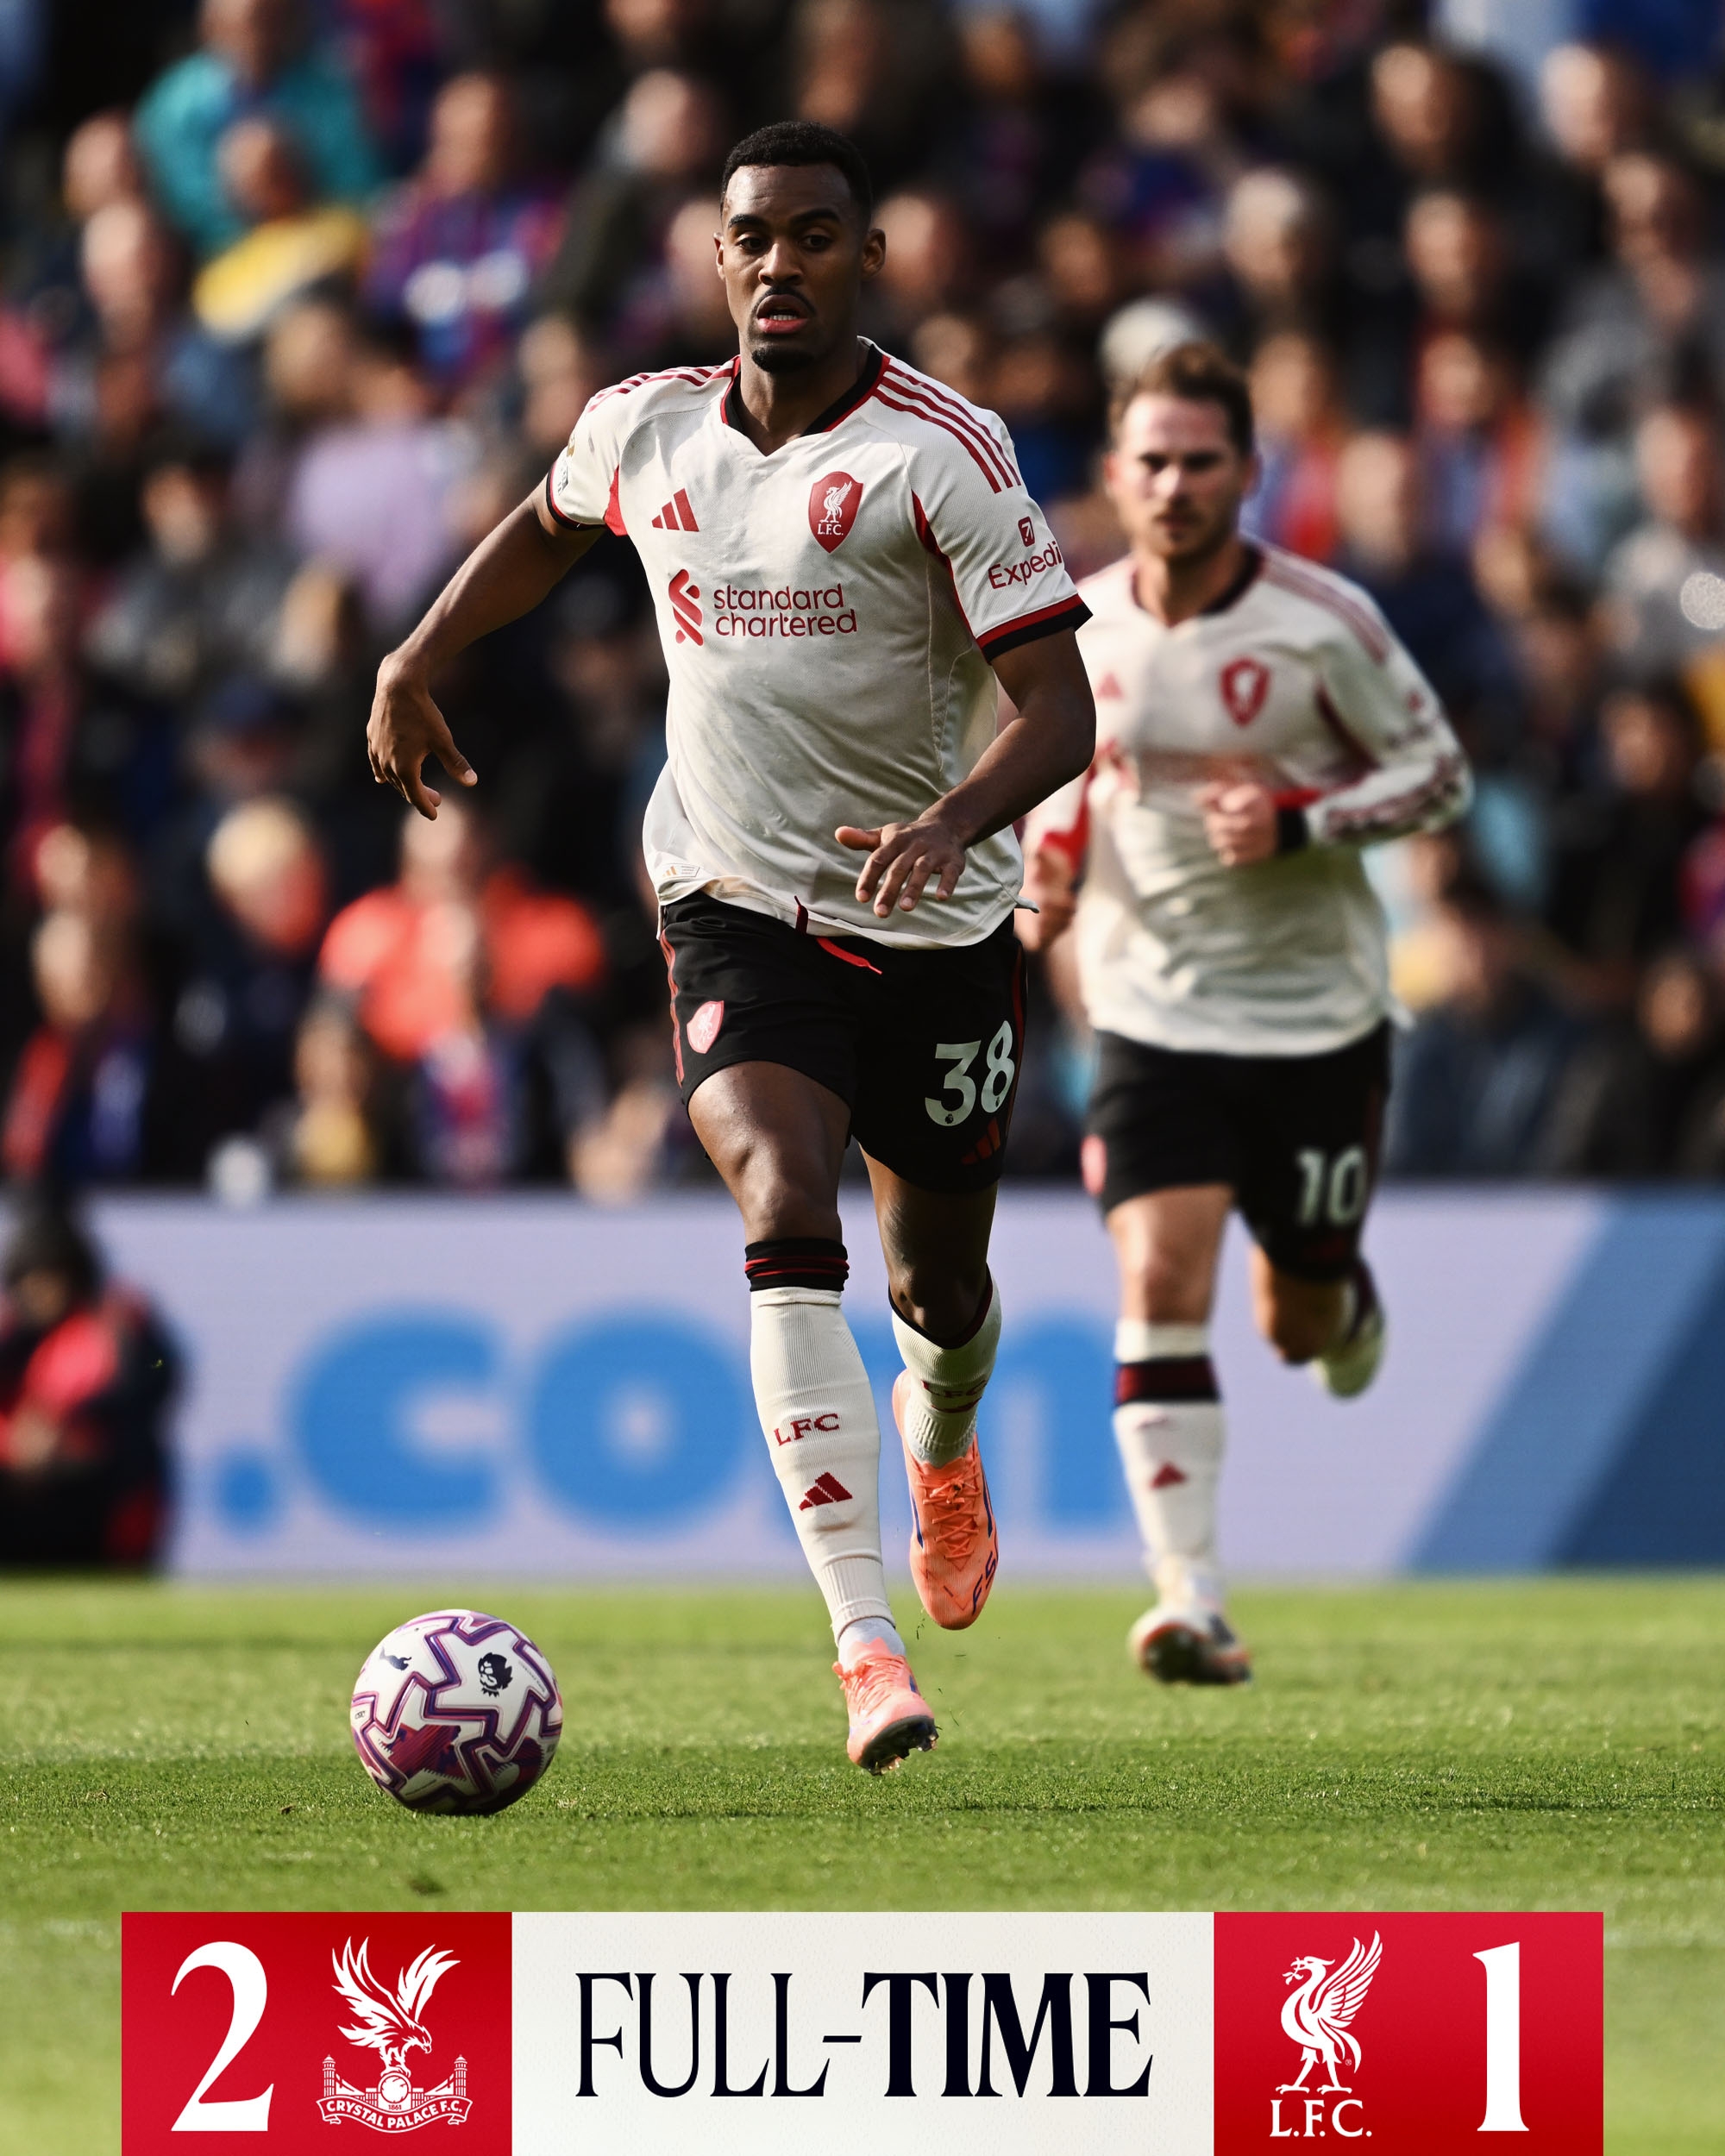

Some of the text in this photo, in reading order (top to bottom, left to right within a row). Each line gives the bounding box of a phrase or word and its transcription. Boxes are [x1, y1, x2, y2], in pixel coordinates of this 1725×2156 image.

[988, 540, 1063, 590] Expedi
[713, 583, 844, 611] standard
[715, 608, 858, 637] chartered
[925, 1020, 1015, 1127] 38
[1296, 1148, 1367, 1225] 10
[774, 1413, 840, 1447] LFC
